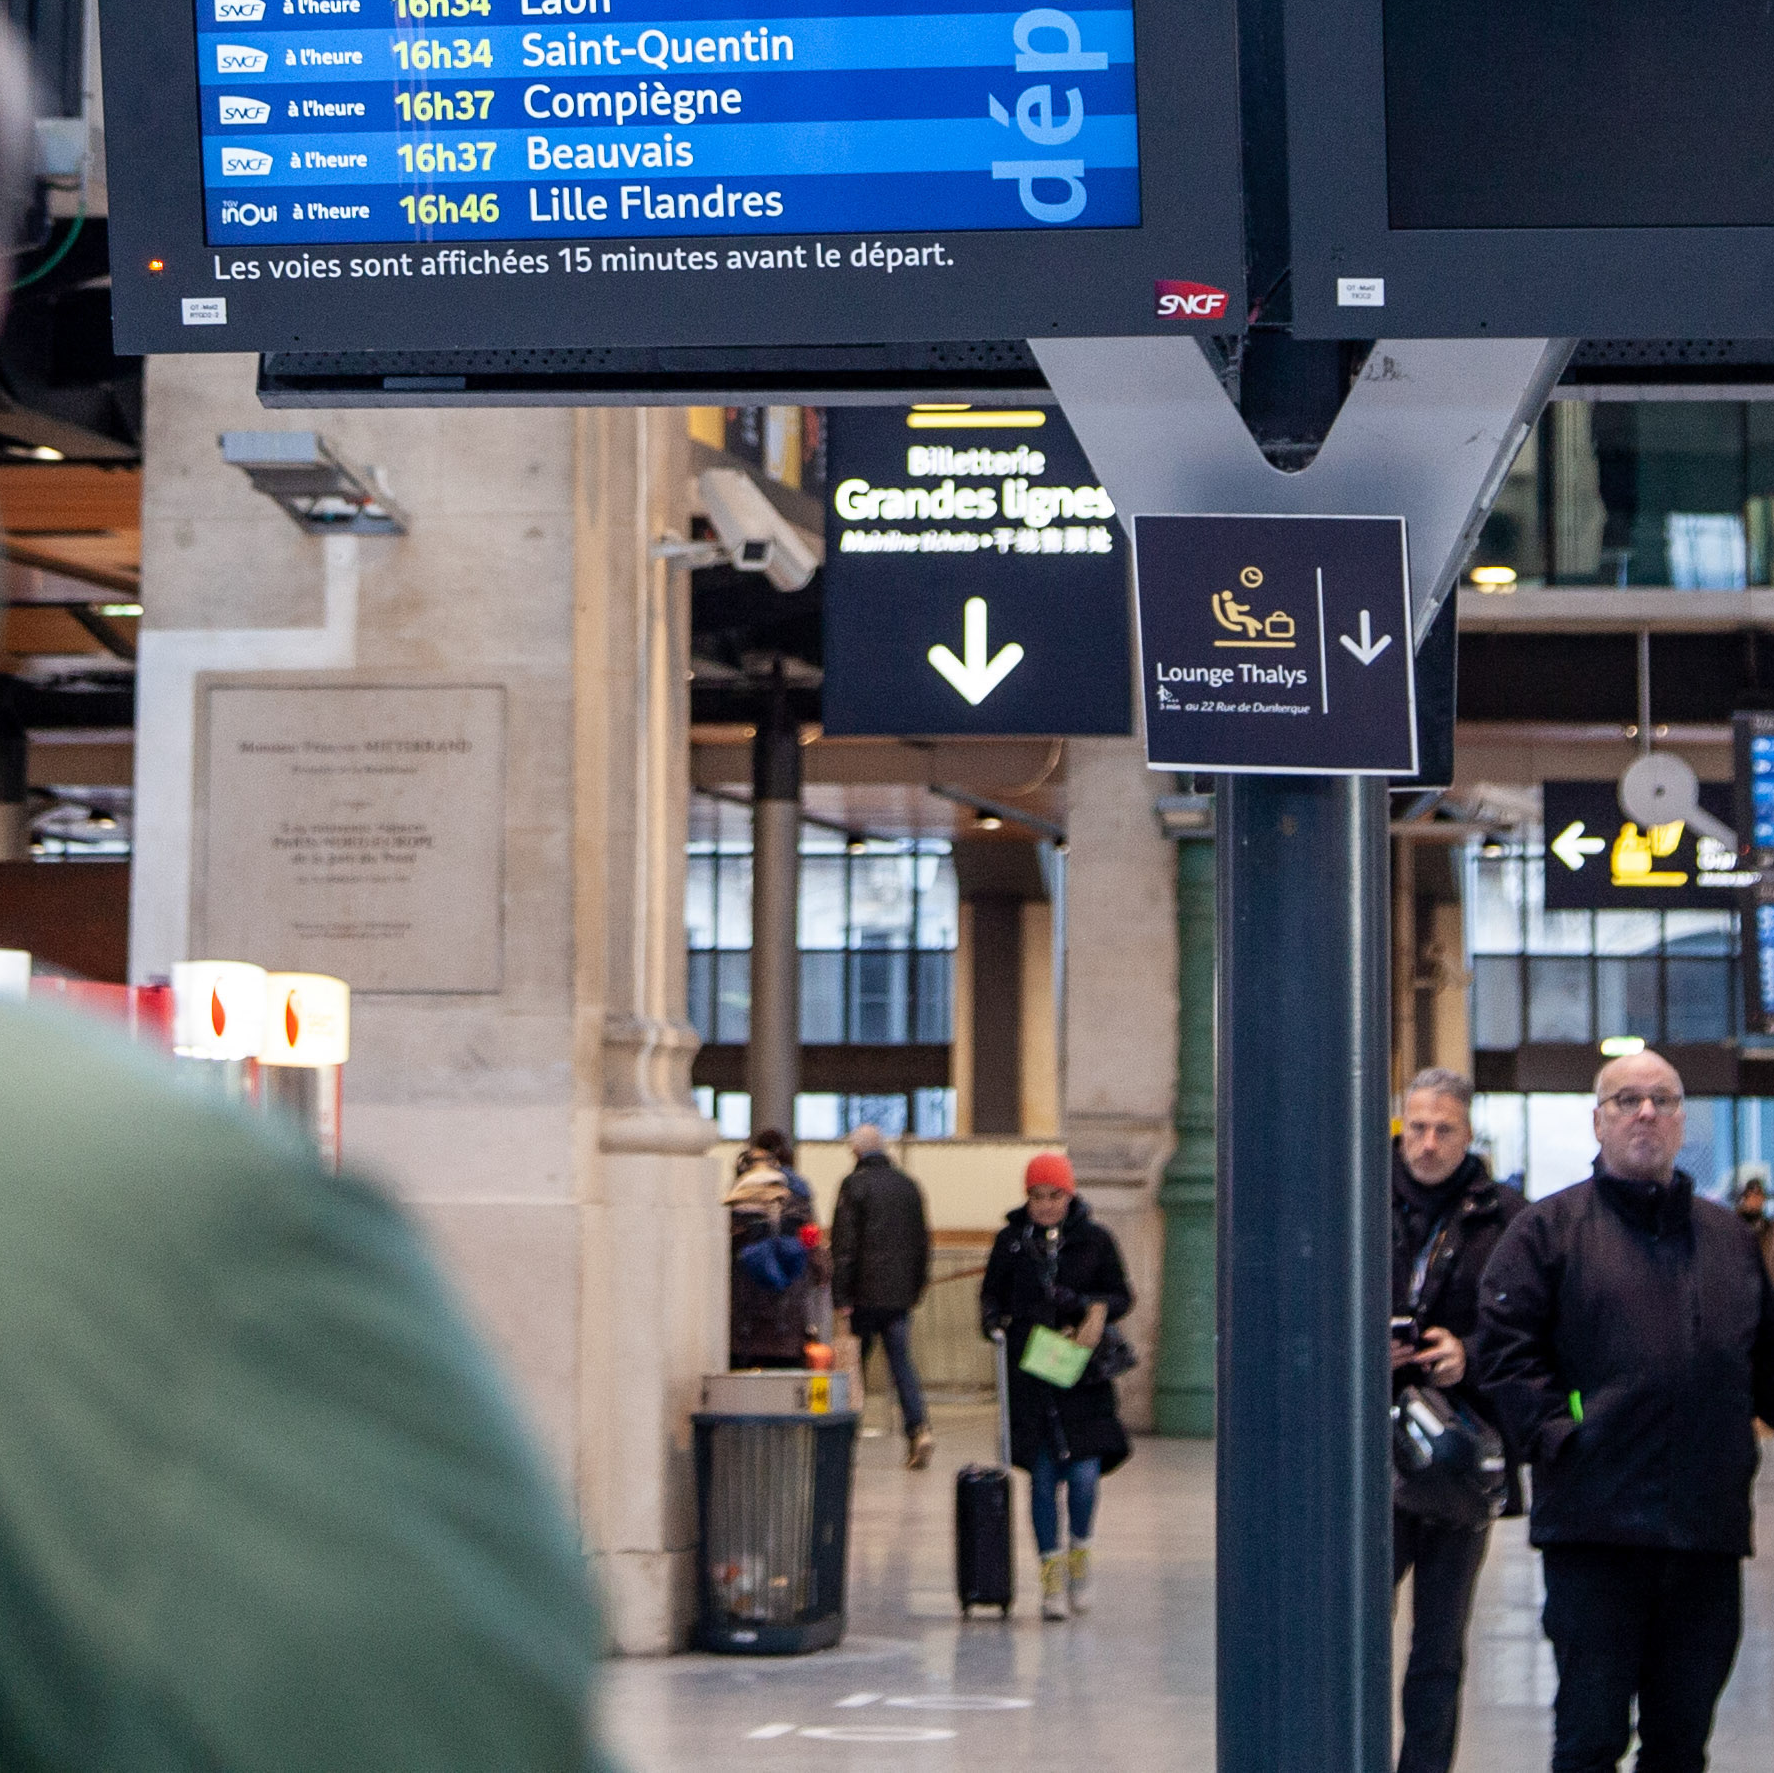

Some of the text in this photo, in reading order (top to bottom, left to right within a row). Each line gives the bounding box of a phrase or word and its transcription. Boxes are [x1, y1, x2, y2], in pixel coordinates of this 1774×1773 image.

[394, 81, 743, 127] 16h37 Compiègne
[907, 445, 1046, 476] Billetterie
[834, 478, 1115, 527] Grandes lignes
[1157, 663, 1307, 688] Lounge Thalys
